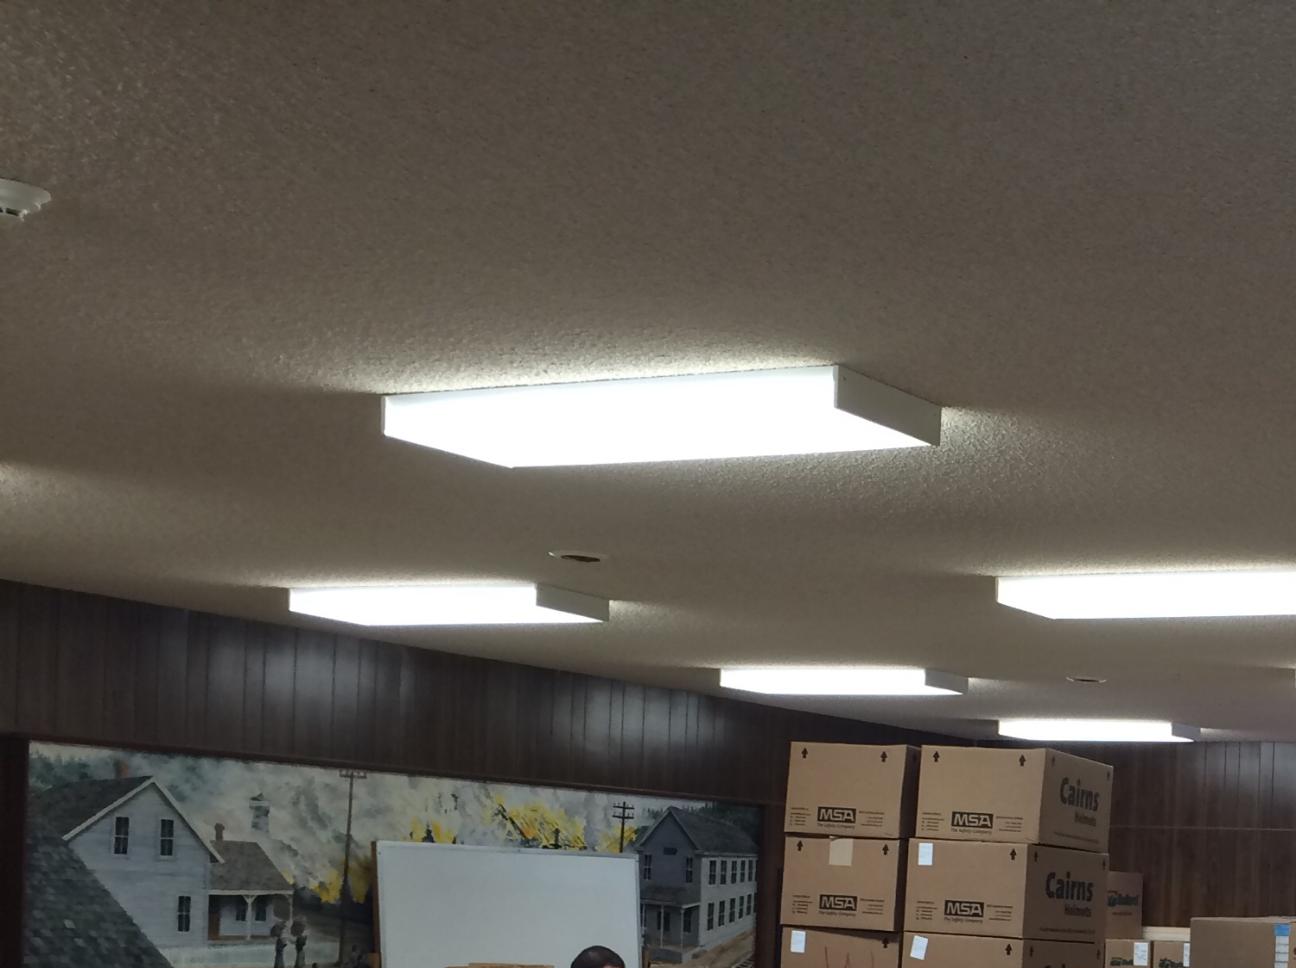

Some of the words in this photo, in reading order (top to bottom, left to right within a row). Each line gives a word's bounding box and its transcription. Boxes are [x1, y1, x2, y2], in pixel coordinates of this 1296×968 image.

[1060, 777, 1100, 811] Cairns
[818, 807, 855, 822] MSA
[952, 812, 992, 827] MSA
[1045, 871, 1094, 903] Cairns
[821, 896, 856, 910] MSA
[945, 901, 983, 916] MSA
